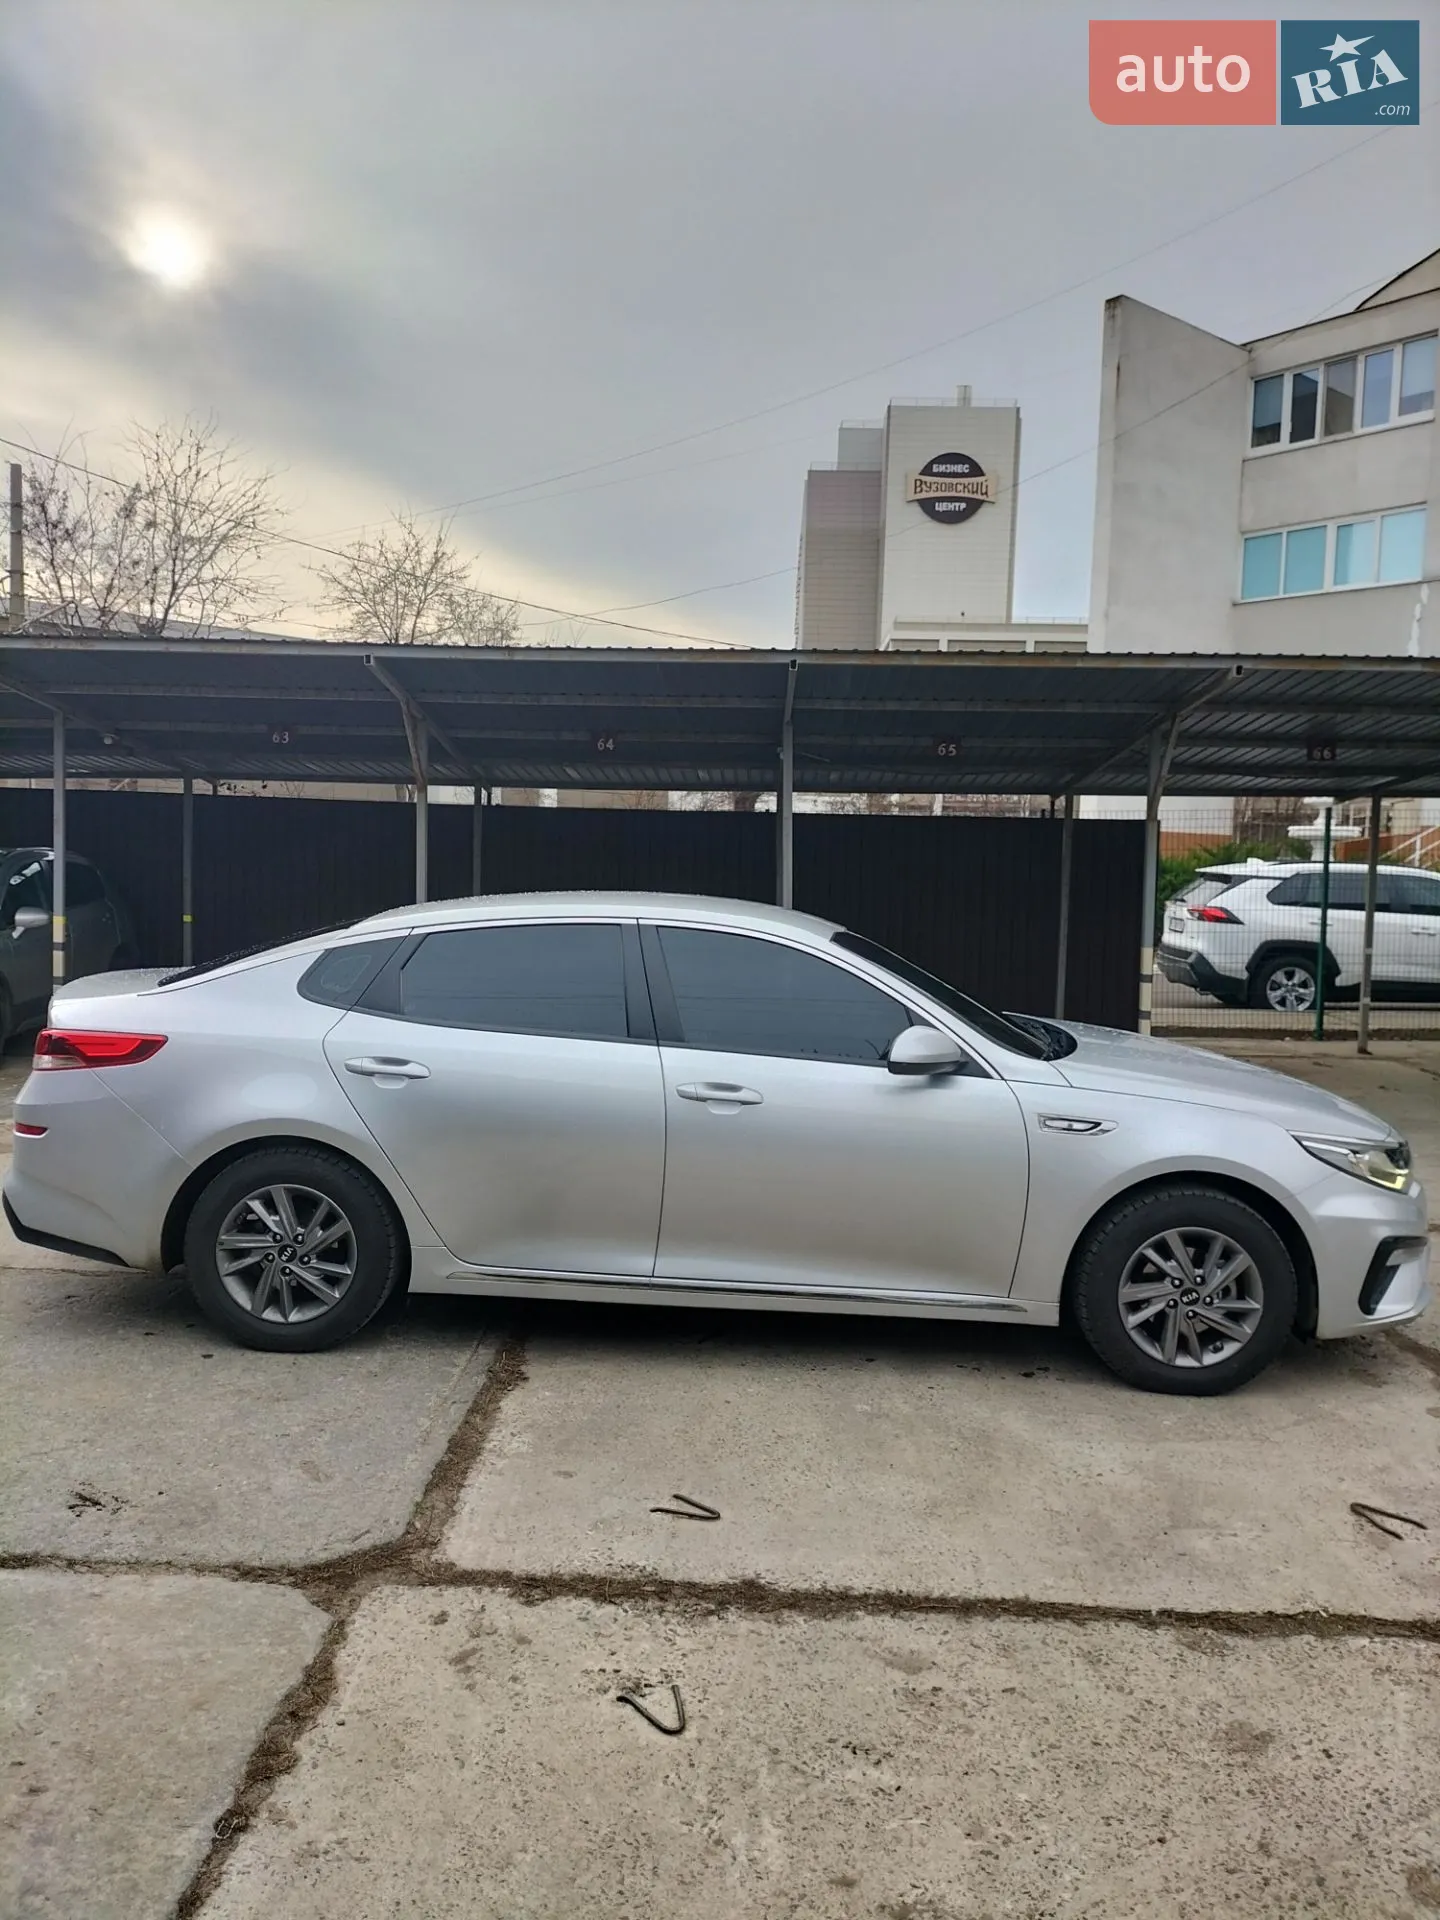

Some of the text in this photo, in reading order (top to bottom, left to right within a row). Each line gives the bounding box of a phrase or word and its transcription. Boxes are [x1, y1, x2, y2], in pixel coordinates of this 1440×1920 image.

[932, 464, 970, 473] БИЗНЕС
[935, 502, 967, 512] ЦЕНТР
[272, 731, 289, 744] 63
[597, 738, 615, 751] 64
[938, 743, 957, 756] 65
[280, 1247, 294, 1262] KIA
[1181, 1291, 1199, 1303] KIA
